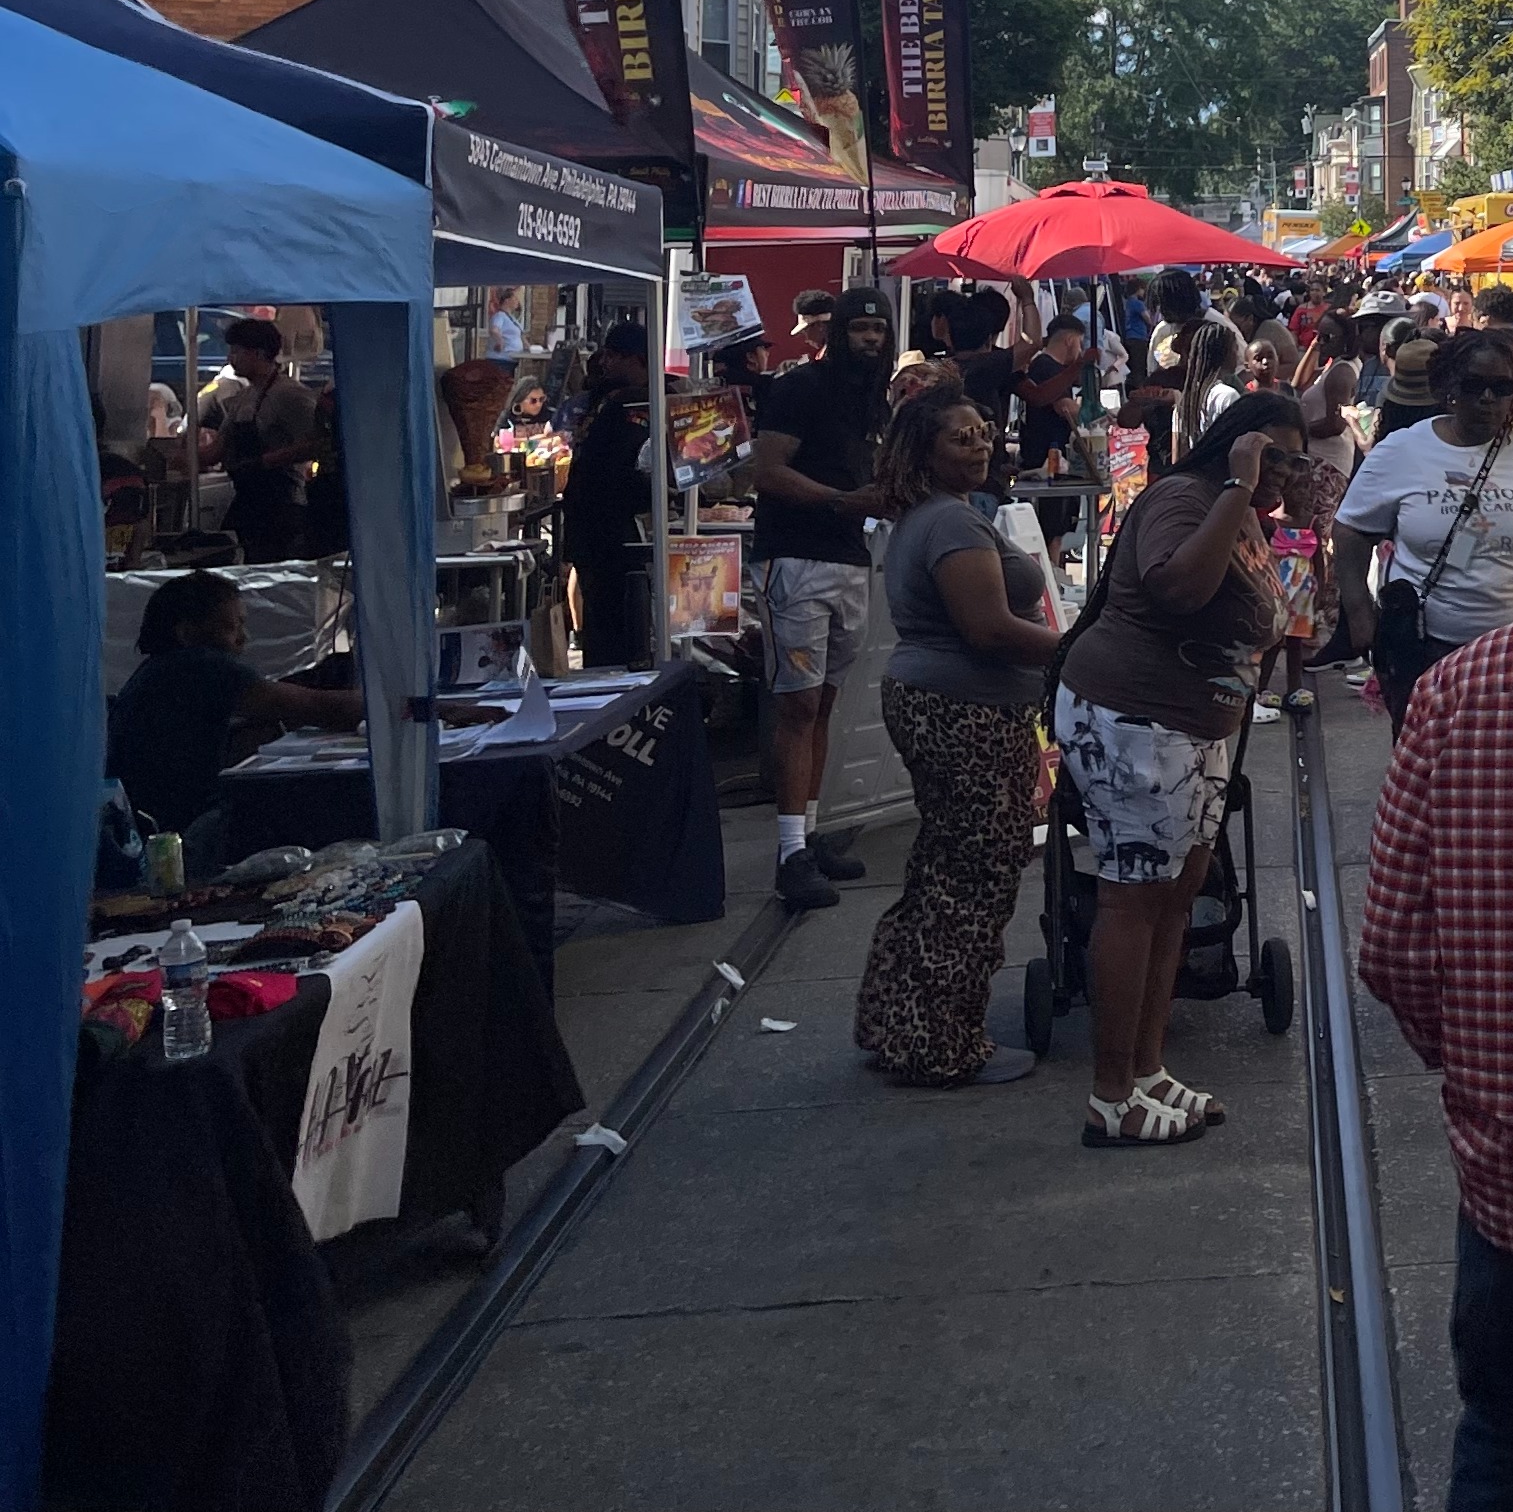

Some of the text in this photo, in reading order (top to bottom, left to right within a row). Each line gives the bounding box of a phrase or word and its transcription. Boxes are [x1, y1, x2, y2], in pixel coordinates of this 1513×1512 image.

[901, 39, 923, 99] THE
[924, 29, 948, 132] BIRRIA
[517, 202, 581, 249] 215-849-6592
[673, 415, 693, 429] NEW
[606, 723, 657, 767] OLL
